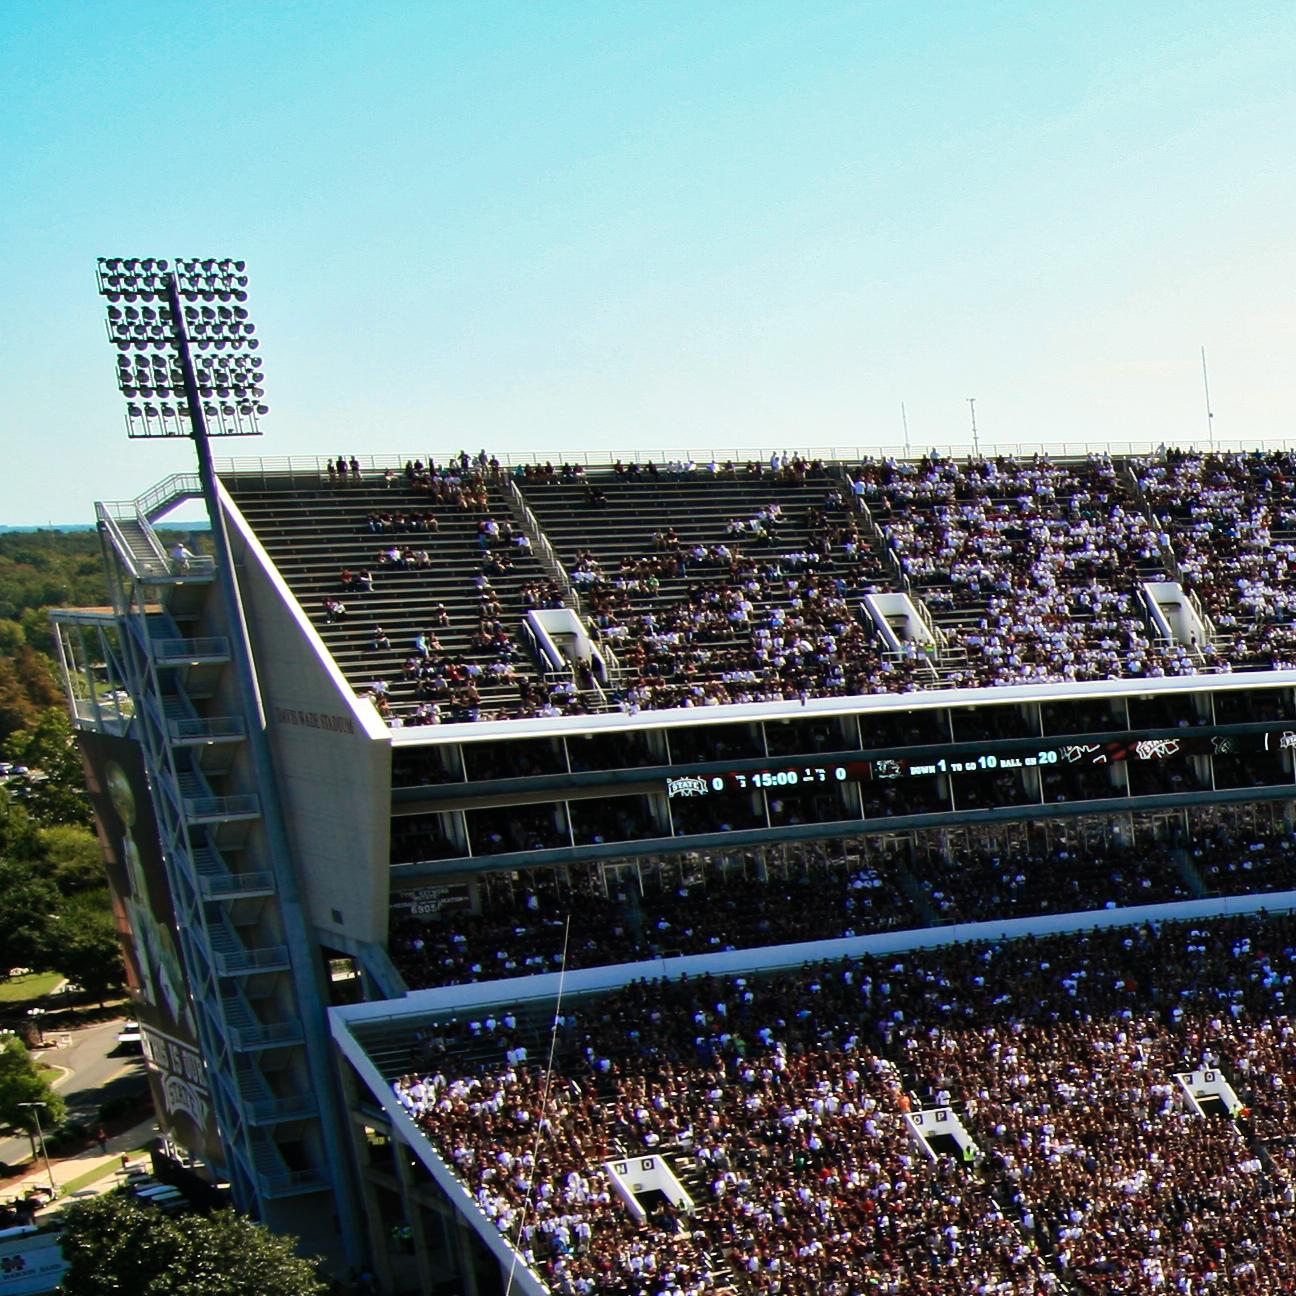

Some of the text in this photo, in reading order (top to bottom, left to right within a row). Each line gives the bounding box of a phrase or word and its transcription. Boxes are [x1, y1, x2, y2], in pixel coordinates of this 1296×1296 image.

[978, 756, 997, 769] 10
[1038, 751, 1057, 764] 20
[752, 771, 798, 788] 15:00
[835, 767, 846, 780] 0
[712, 778, 723, 791] 0
